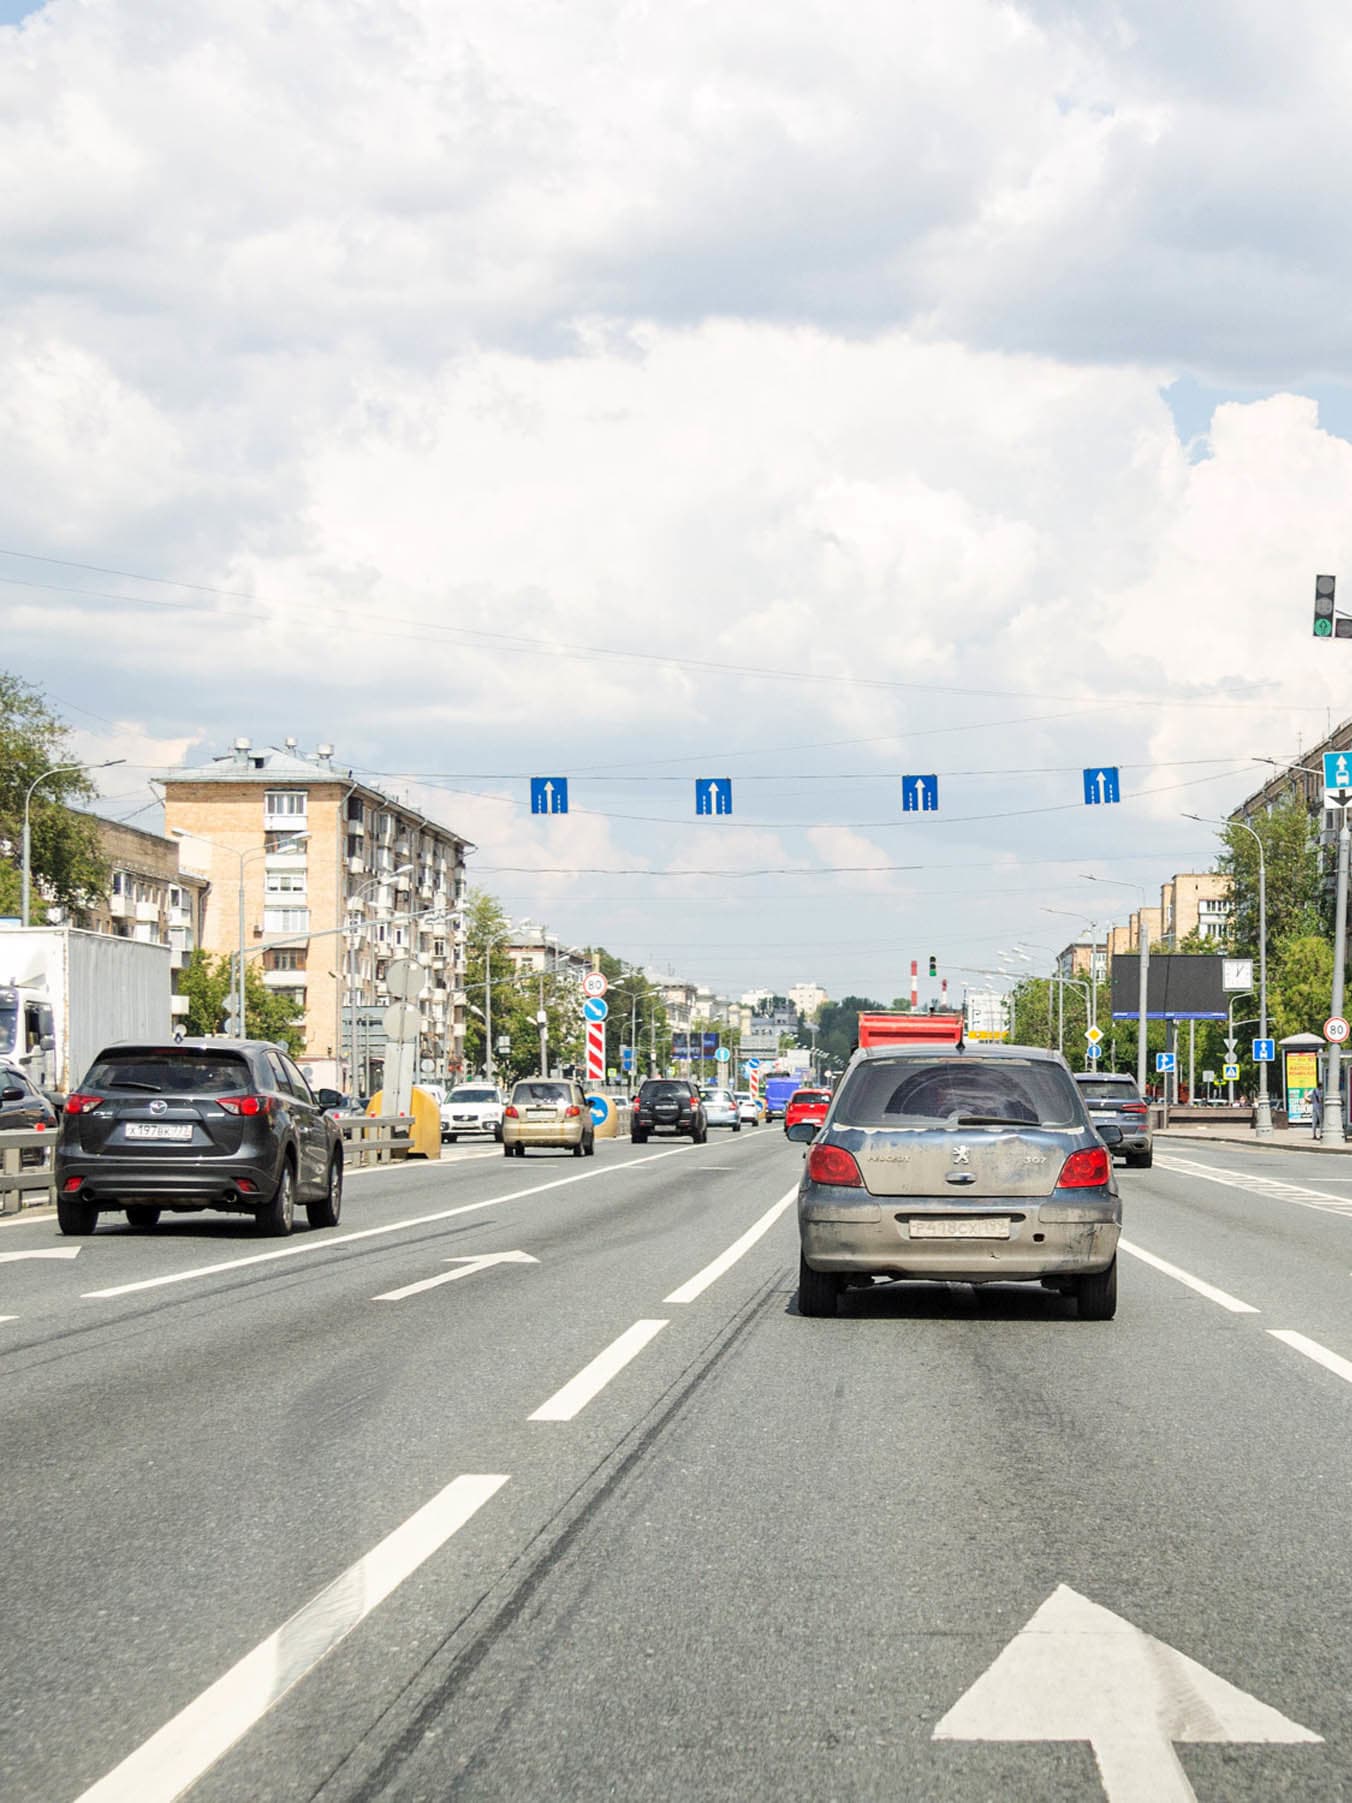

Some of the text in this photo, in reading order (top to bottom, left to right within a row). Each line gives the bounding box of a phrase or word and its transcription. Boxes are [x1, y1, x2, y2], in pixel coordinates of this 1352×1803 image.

[588, 980, 602, 991] 80
[1330, 1025, 1343, 1035] 80
[1023, 1156, 1047, 1164] 307
